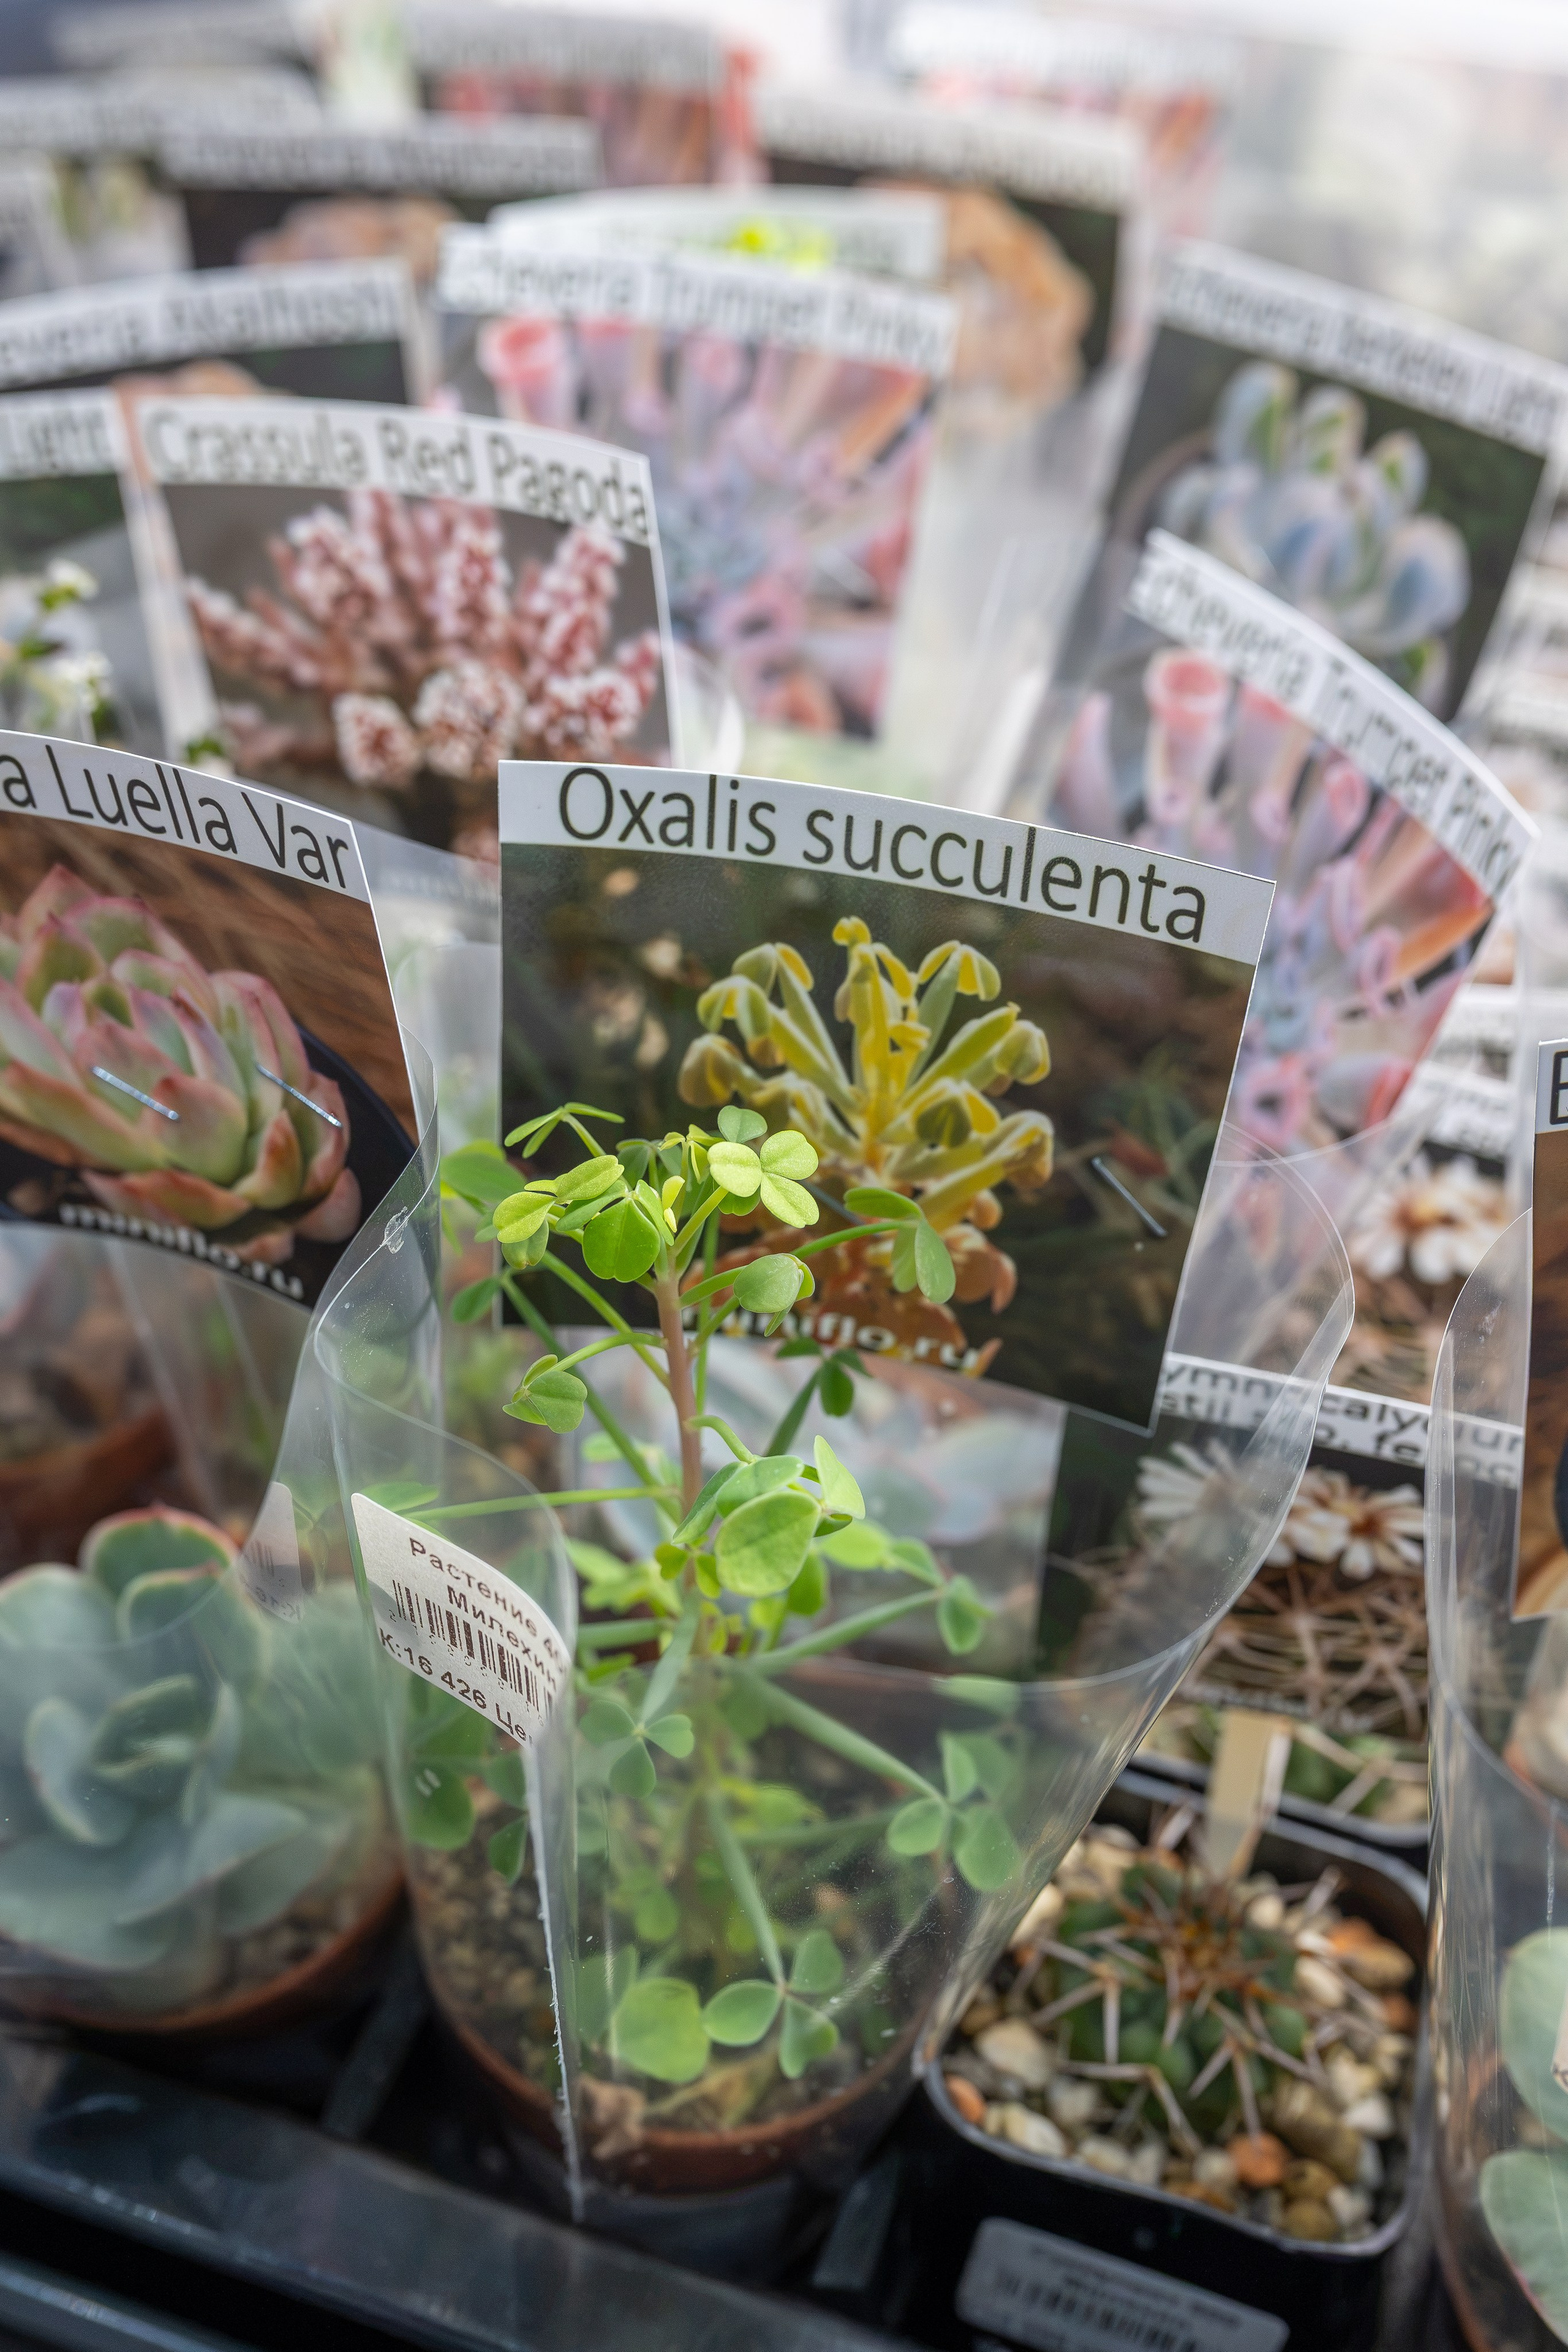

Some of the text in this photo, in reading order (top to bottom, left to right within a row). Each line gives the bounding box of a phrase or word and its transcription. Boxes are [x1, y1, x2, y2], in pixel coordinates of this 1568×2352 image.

[145, 407, 649, 537] Crassula Red Pagoda
[45, 744, 238, 854] Luella
[241, 791, 349, 889] Var
[558, 766, 1208, 943] Oxalis succulenta
[409, 1537, 538, 1638] Растение
[380, 1627, 533, 1745] К:16 426 Це
